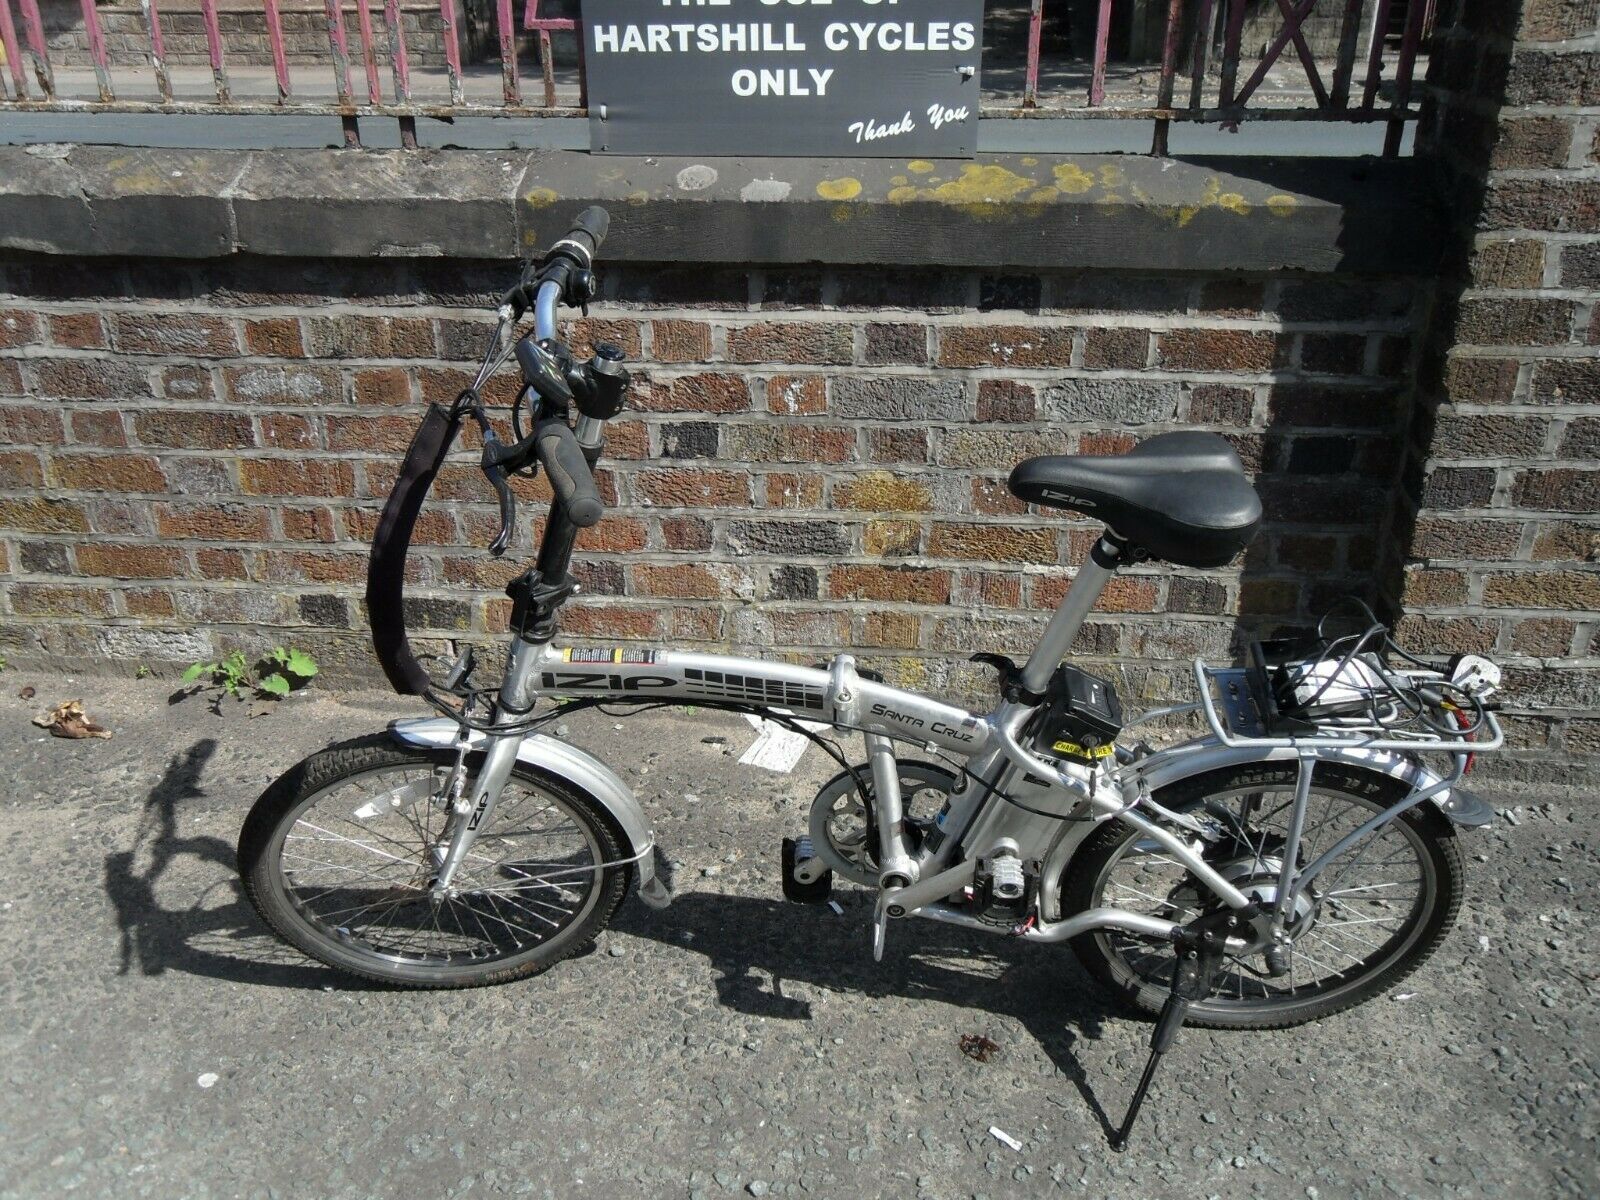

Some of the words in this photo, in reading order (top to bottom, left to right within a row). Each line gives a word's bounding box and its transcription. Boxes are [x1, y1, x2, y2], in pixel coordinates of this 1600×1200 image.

[593, 23, 806, 53] HARTSHILL
[823, 22, 975, 52] CYCLES
[731, 68, 835, 97] ONLY
[848, 111, 916, 144] Thank
[926, 103, 970, 130] You
[1041, 488, 1097, 507] IZIP
